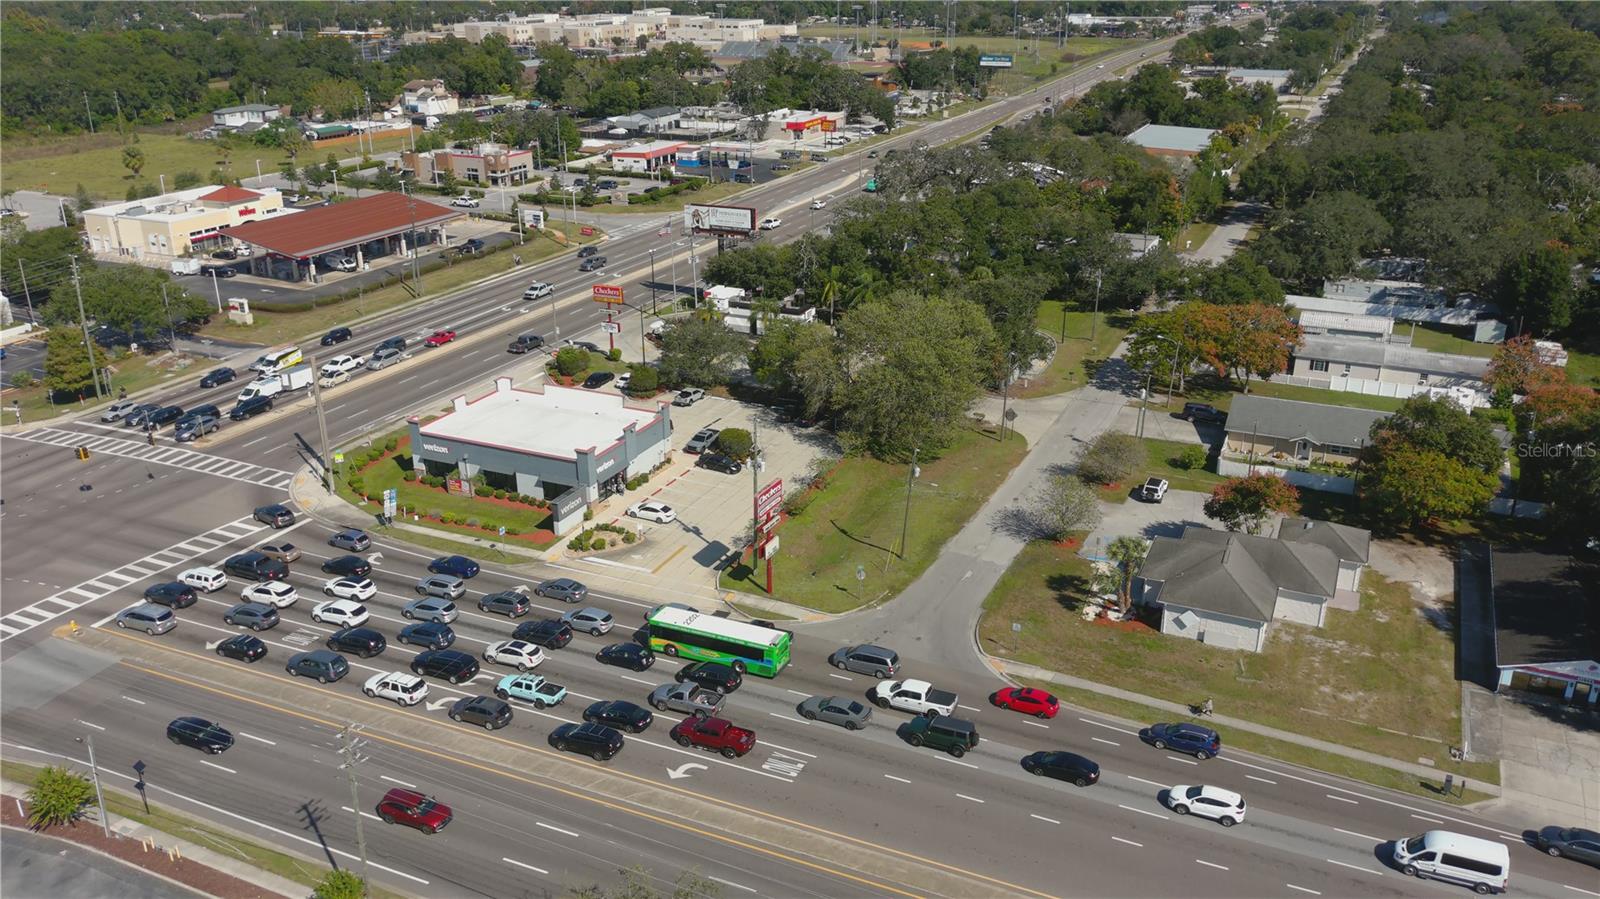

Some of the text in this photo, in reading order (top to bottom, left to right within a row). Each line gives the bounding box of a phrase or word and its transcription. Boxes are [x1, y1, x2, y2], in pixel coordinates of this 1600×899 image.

[423, 443, 449, 454] verizon
[596, 458, 615, 474] verizon
[560, 496, 582, 515] verizon
[761, 751, 808, 777] ONLY
